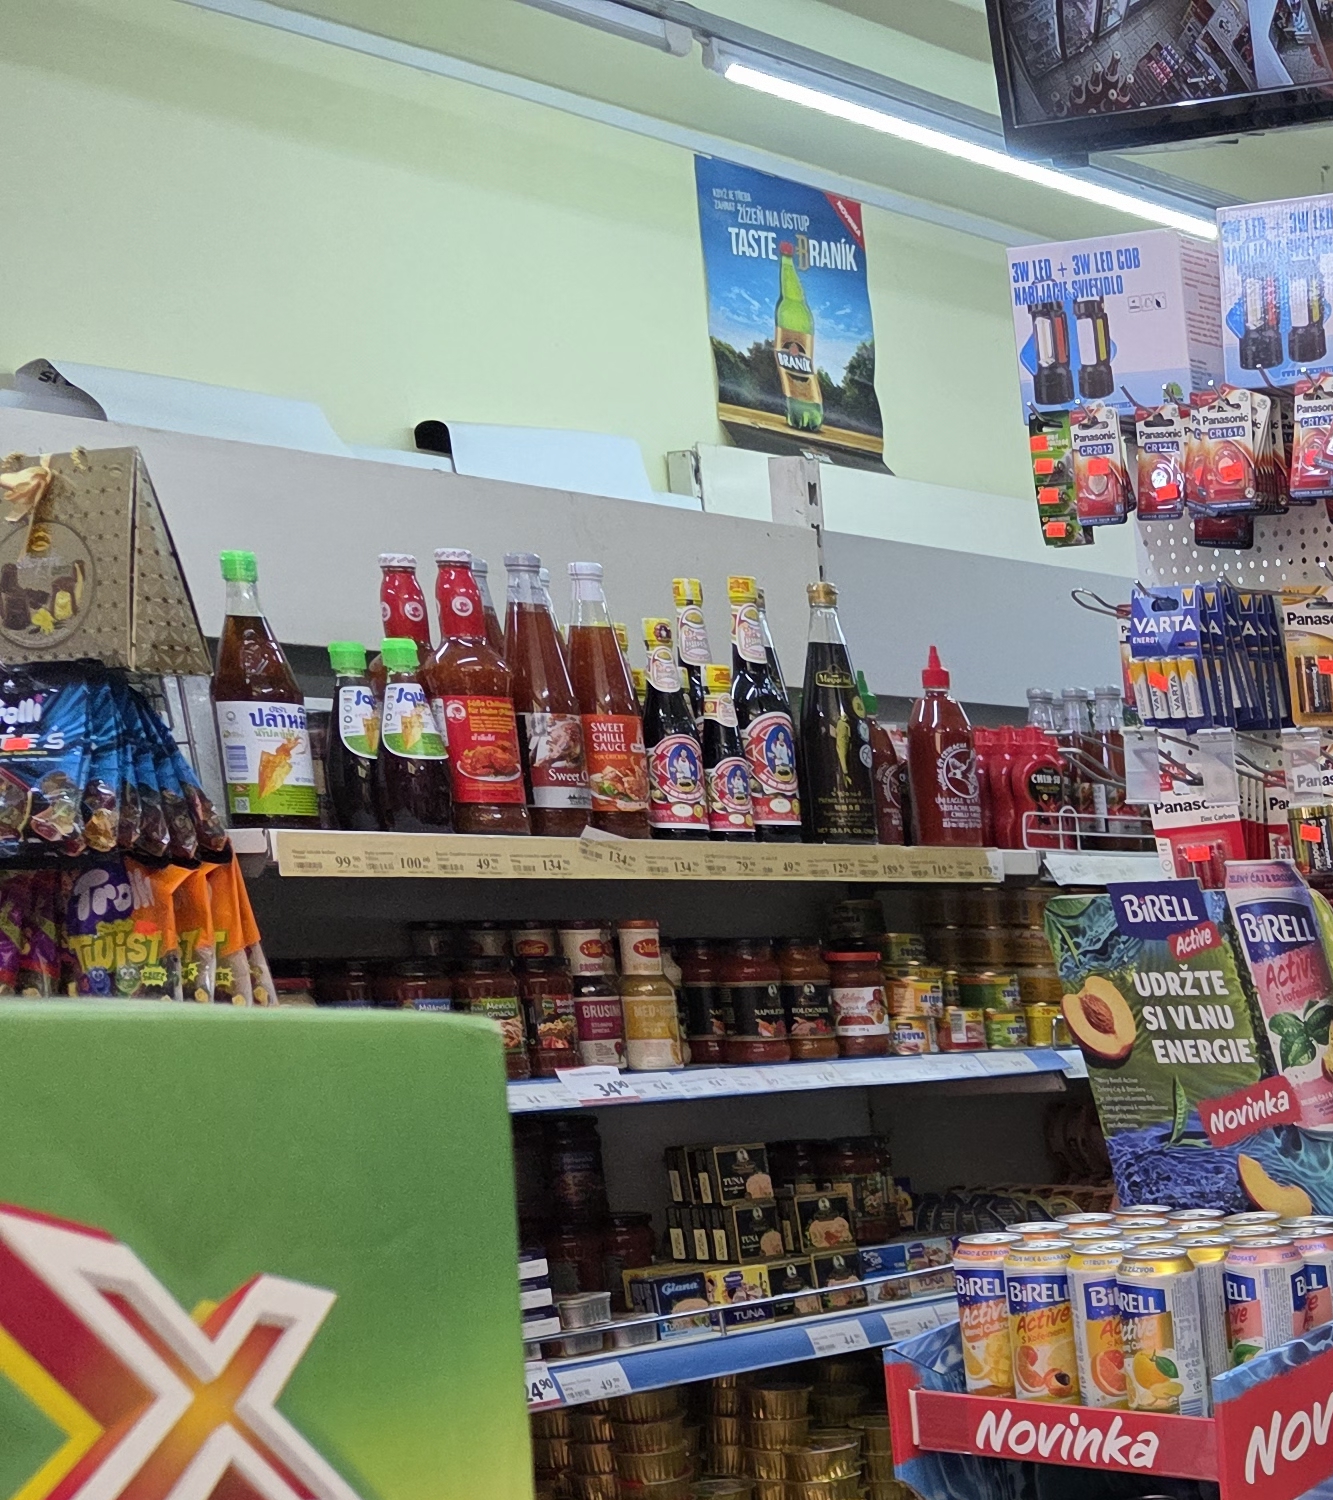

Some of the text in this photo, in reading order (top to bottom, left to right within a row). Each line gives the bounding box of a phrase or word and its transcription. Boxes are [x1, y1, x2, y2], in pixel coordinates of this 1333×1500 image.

[737, 204, 810, 232] ŽÍZEŇ NA ÚSTUP
[728, 227, 778, 260] TASTE
[1012, 261, 1029, 283] 3W
[1032, 259, 1051, 281] LED
[1072, 254, 1090, 275] 3W
[1094, 250, 1114, 273] LED
[1117, 248, 1141, 270] COB
[1202, 412, 1250, 427] Panasonic
[1073, 432, 1117, 445] Panasonic
[1138, 428, 1182, 441] Panasonic
[1209, 427, 1244, 439] CR1616
[1081, 444, 1113, 455] CR2012
[1133, 615, 1197, 633] VARTA
[1132, 636, 1159, 645] ENERGY
[590, 722, 624, 733] SWEET
[592, 733, 624, 743] CHILLI
[593, 743, 627, 753] SAUCE
[548, 769, 579, 782] Sweet
[1121, 895, 1198, 923] BiRELL
[1241, 913, 1316, 943] BiRELL
[1176, 928, 1212, 955] Active
[1134, 964, 1229, 997] UDRŽTE
[1143, 1005, 1235, 1031] SI VLNU
[1210, 1090, 1290, 1134] Novinka
[661, 1281, 698, 1295] Giana
[733, 1307, 765, 1321] TUNA
[1016, 1307, 1071, 1335] Active
[975, 1409, 1160, 1469] Novinka
